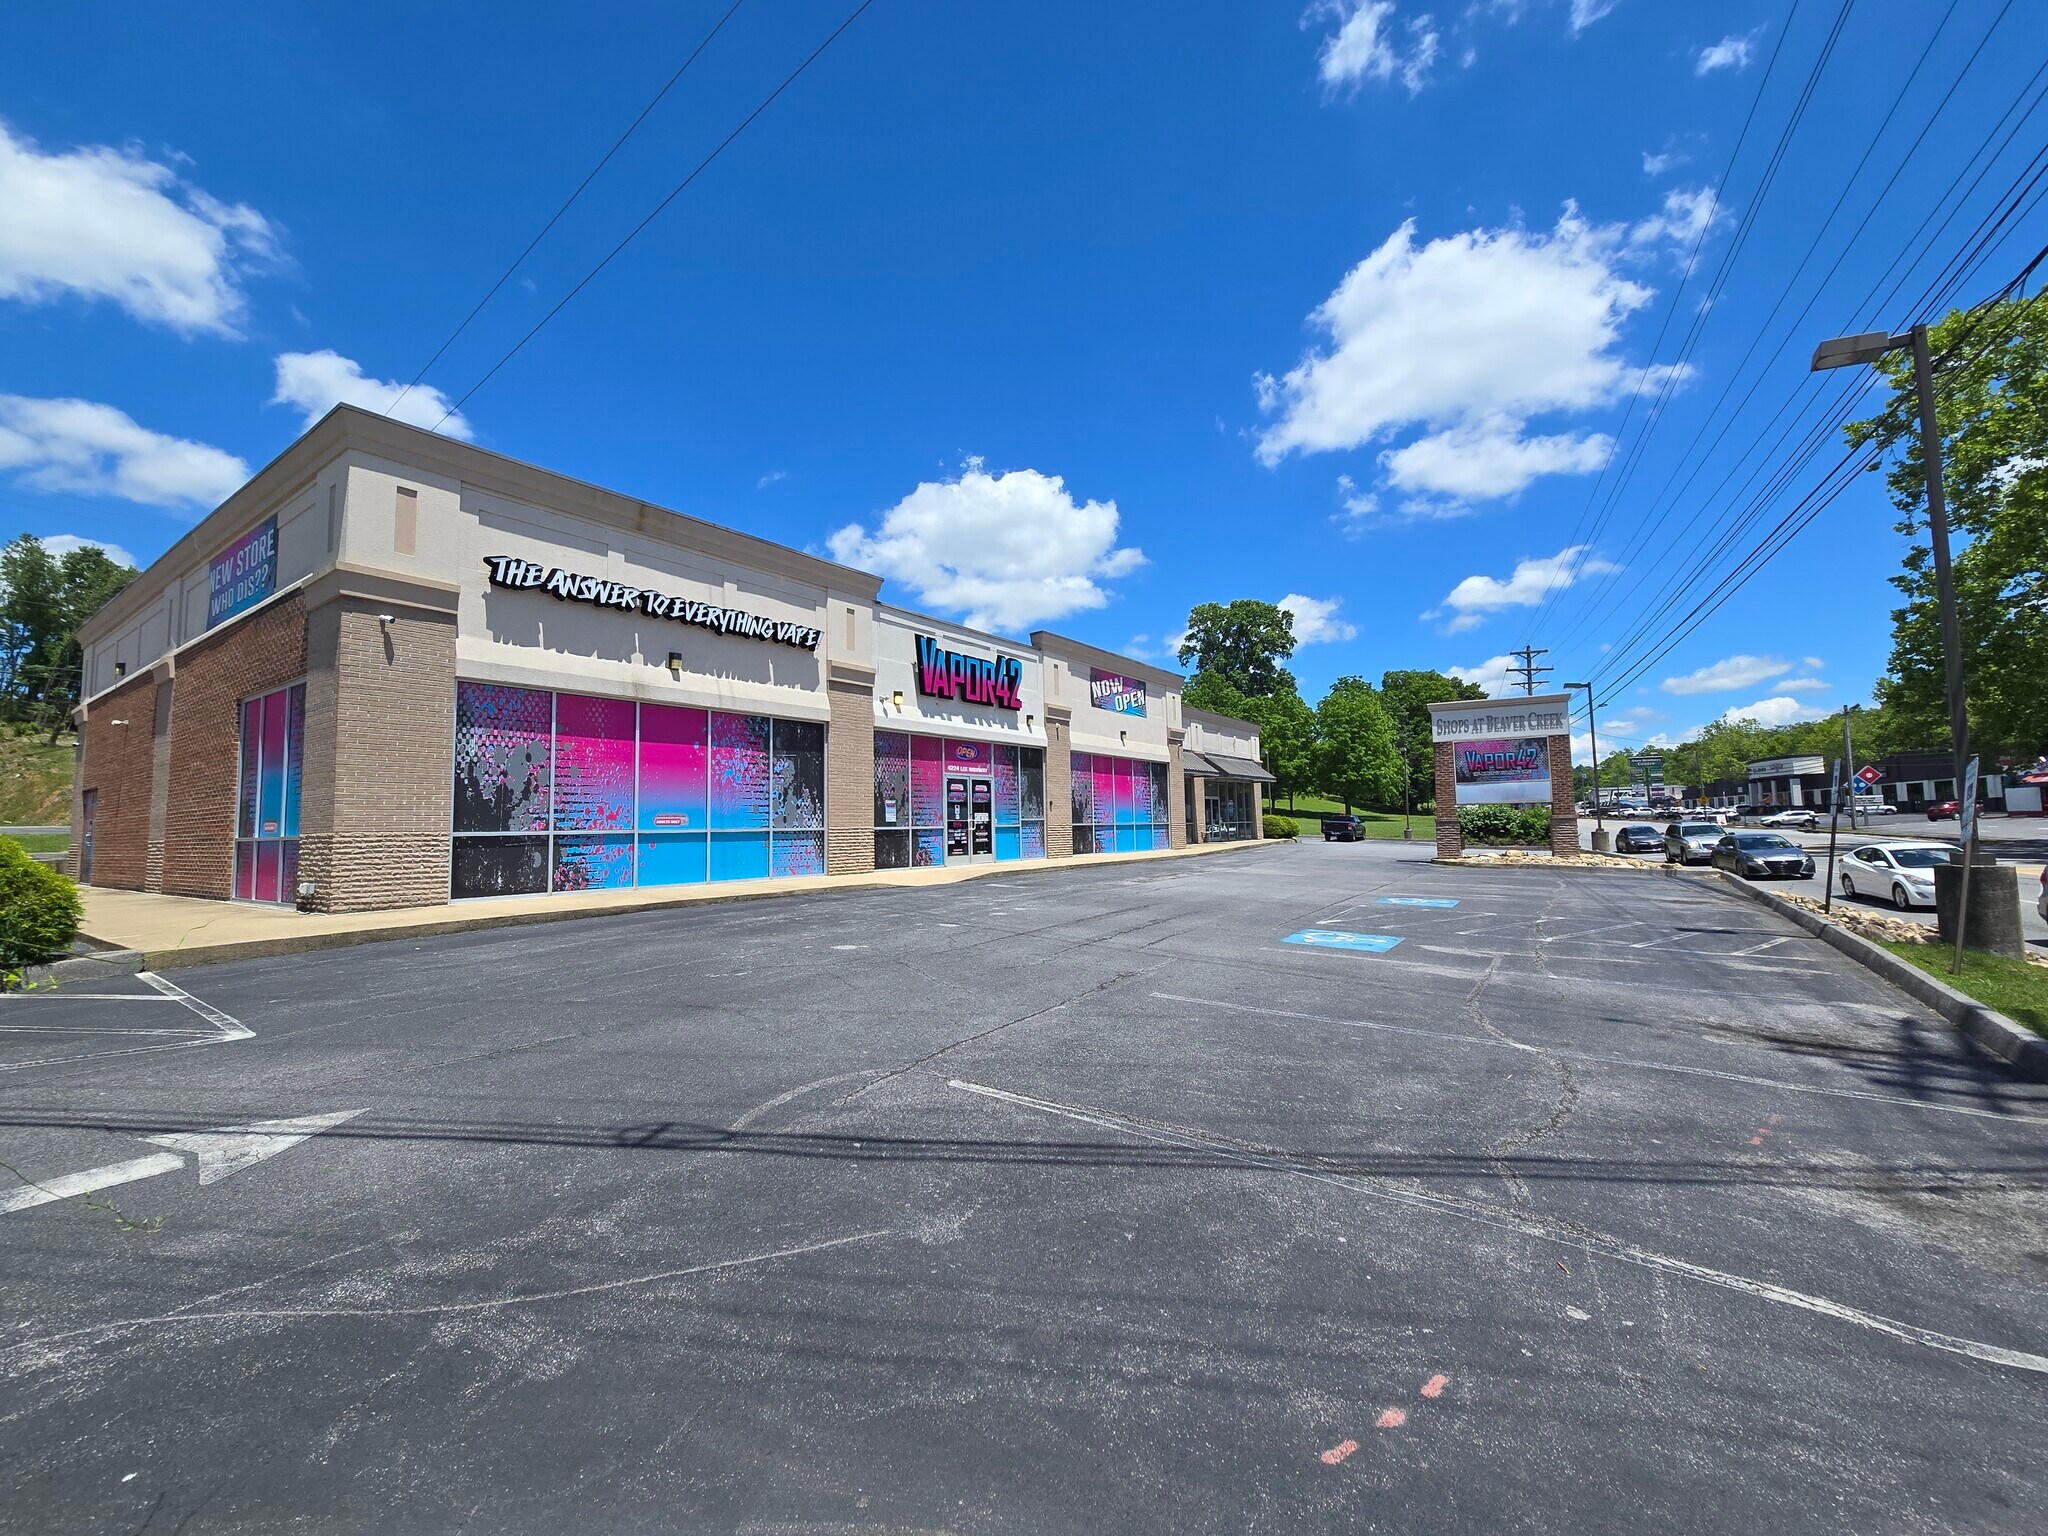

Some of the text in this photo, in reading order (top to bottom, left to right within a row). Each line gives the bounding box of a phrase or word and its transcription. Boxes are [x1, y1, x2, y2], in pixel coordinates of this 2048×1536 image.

[209, 528, 275, 593] NEW STORE
[211, 563, 269, 617] WHO DIS??
[486, 556, 826, 652] THE ANSWER TO EVERYTHING VAPE!
[1091, 676, 1124, 699] NOW
[1114, 689, 1145, 712] OPEN
[1436, 718, 1469, 737] SHOPS
[1486, 714, 1526, 733] BEAVER
[1527, 711, 1564, 731] CREEK
[957, 746, 976, 759] OPEN
